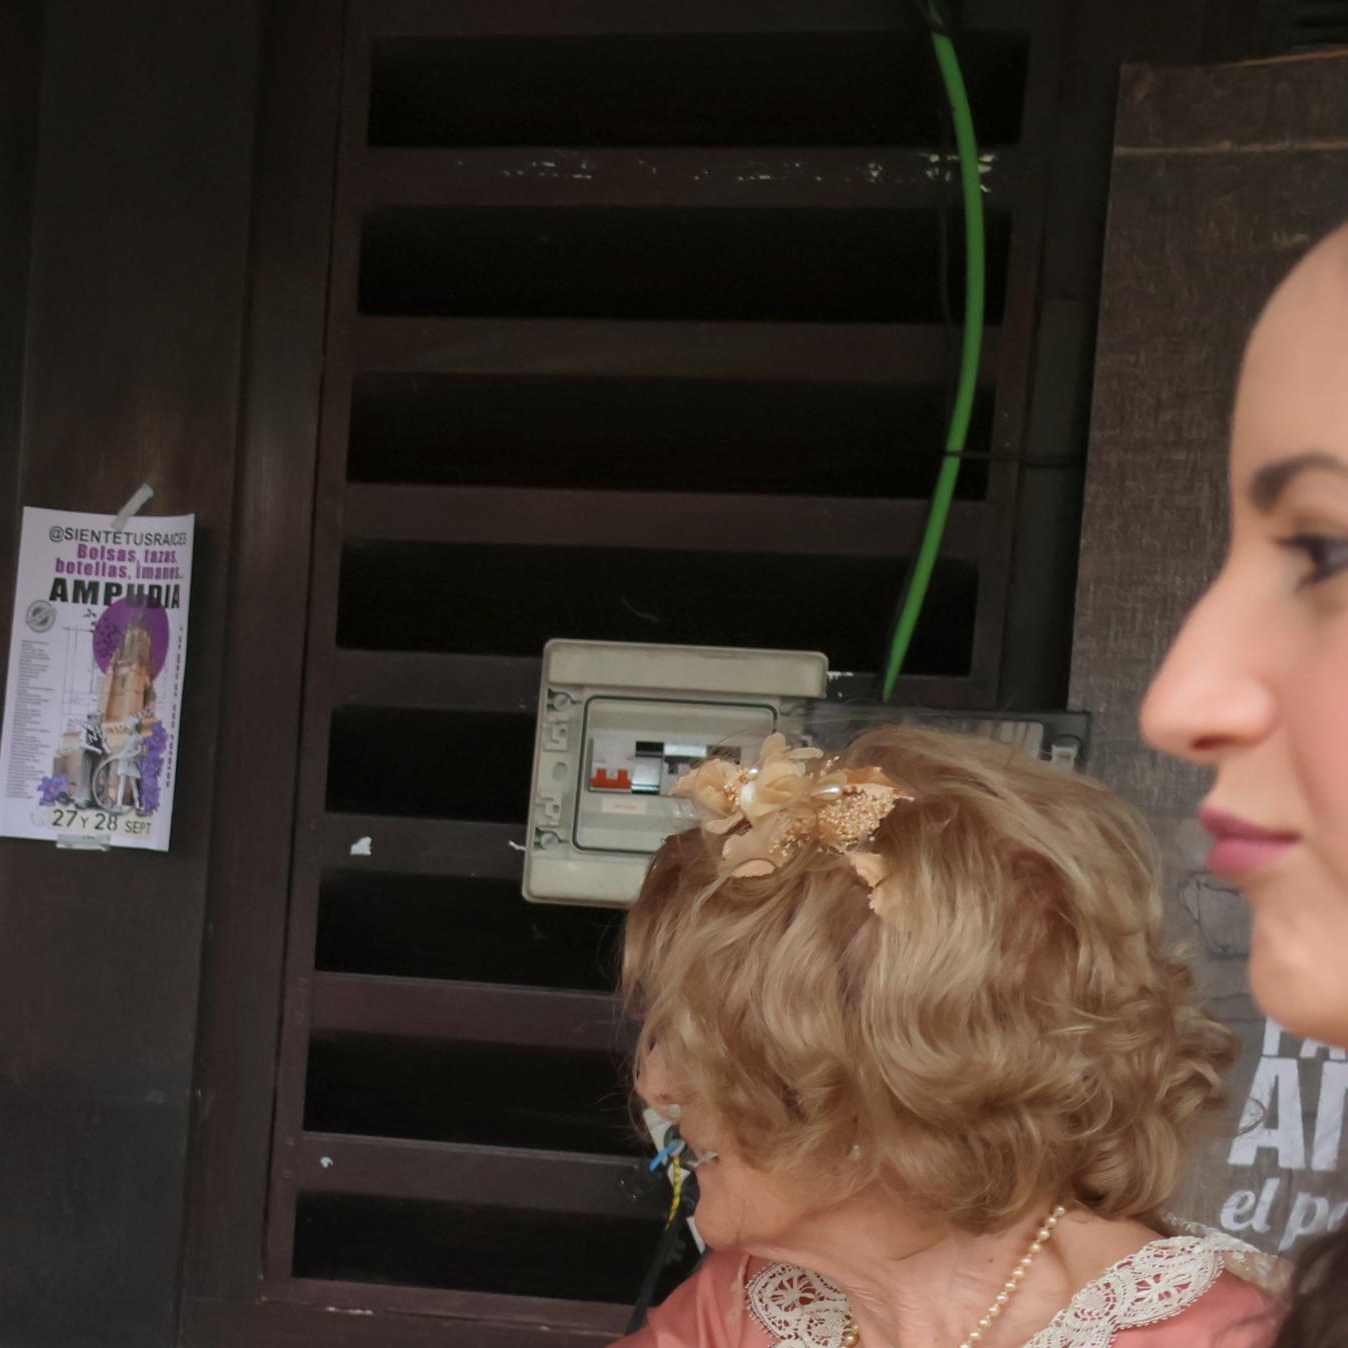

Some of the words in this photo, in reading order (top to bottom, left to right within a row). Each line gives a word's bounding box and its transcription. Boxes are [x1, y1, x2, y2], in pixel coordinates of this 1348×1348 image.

[49, 525, 187, 546] @SIENTETUSRAICES
[77, 543, 140, 563] Bolsas,
[55, 557, 132, 580] botellas,
[49, 577, 181, 609] AMPUDIA
[51, 808, 78, 828] 27
[81, 816, 90, 829] Y
[94, 812, 118, 832] 28
[124, 820, 152, 835] SEPT
[1220, 1177, 1281, 1234] el
